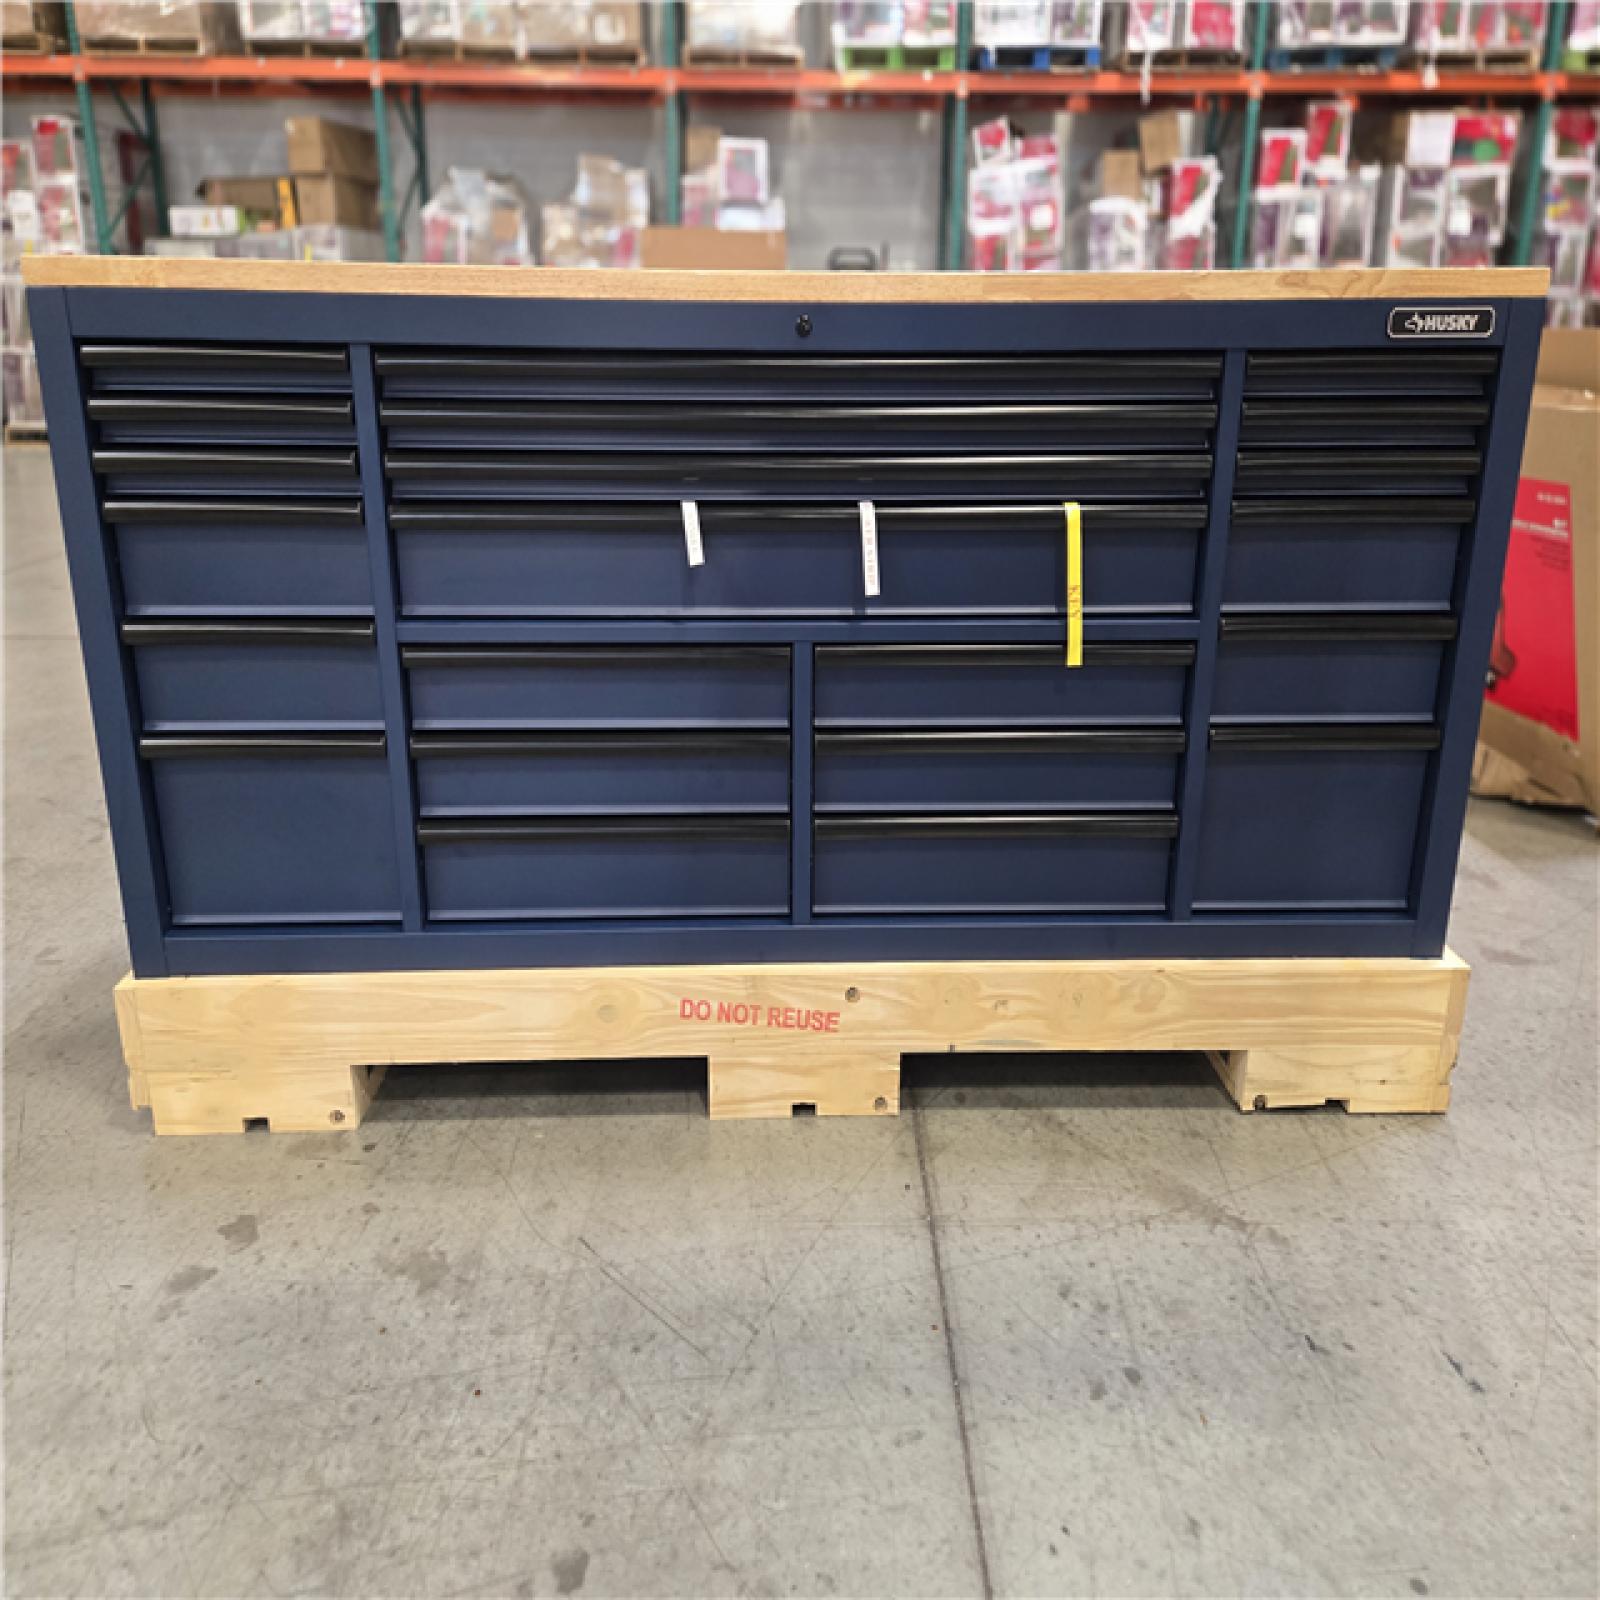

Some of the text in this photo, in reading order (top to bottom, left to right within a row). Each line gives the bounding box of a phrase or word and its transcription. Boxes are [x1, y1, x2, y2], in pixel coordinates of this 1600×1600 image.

[1424, 314, 1480, 331] HUSKY
[679, 998, 841, 1033] DO NOT REUSE
